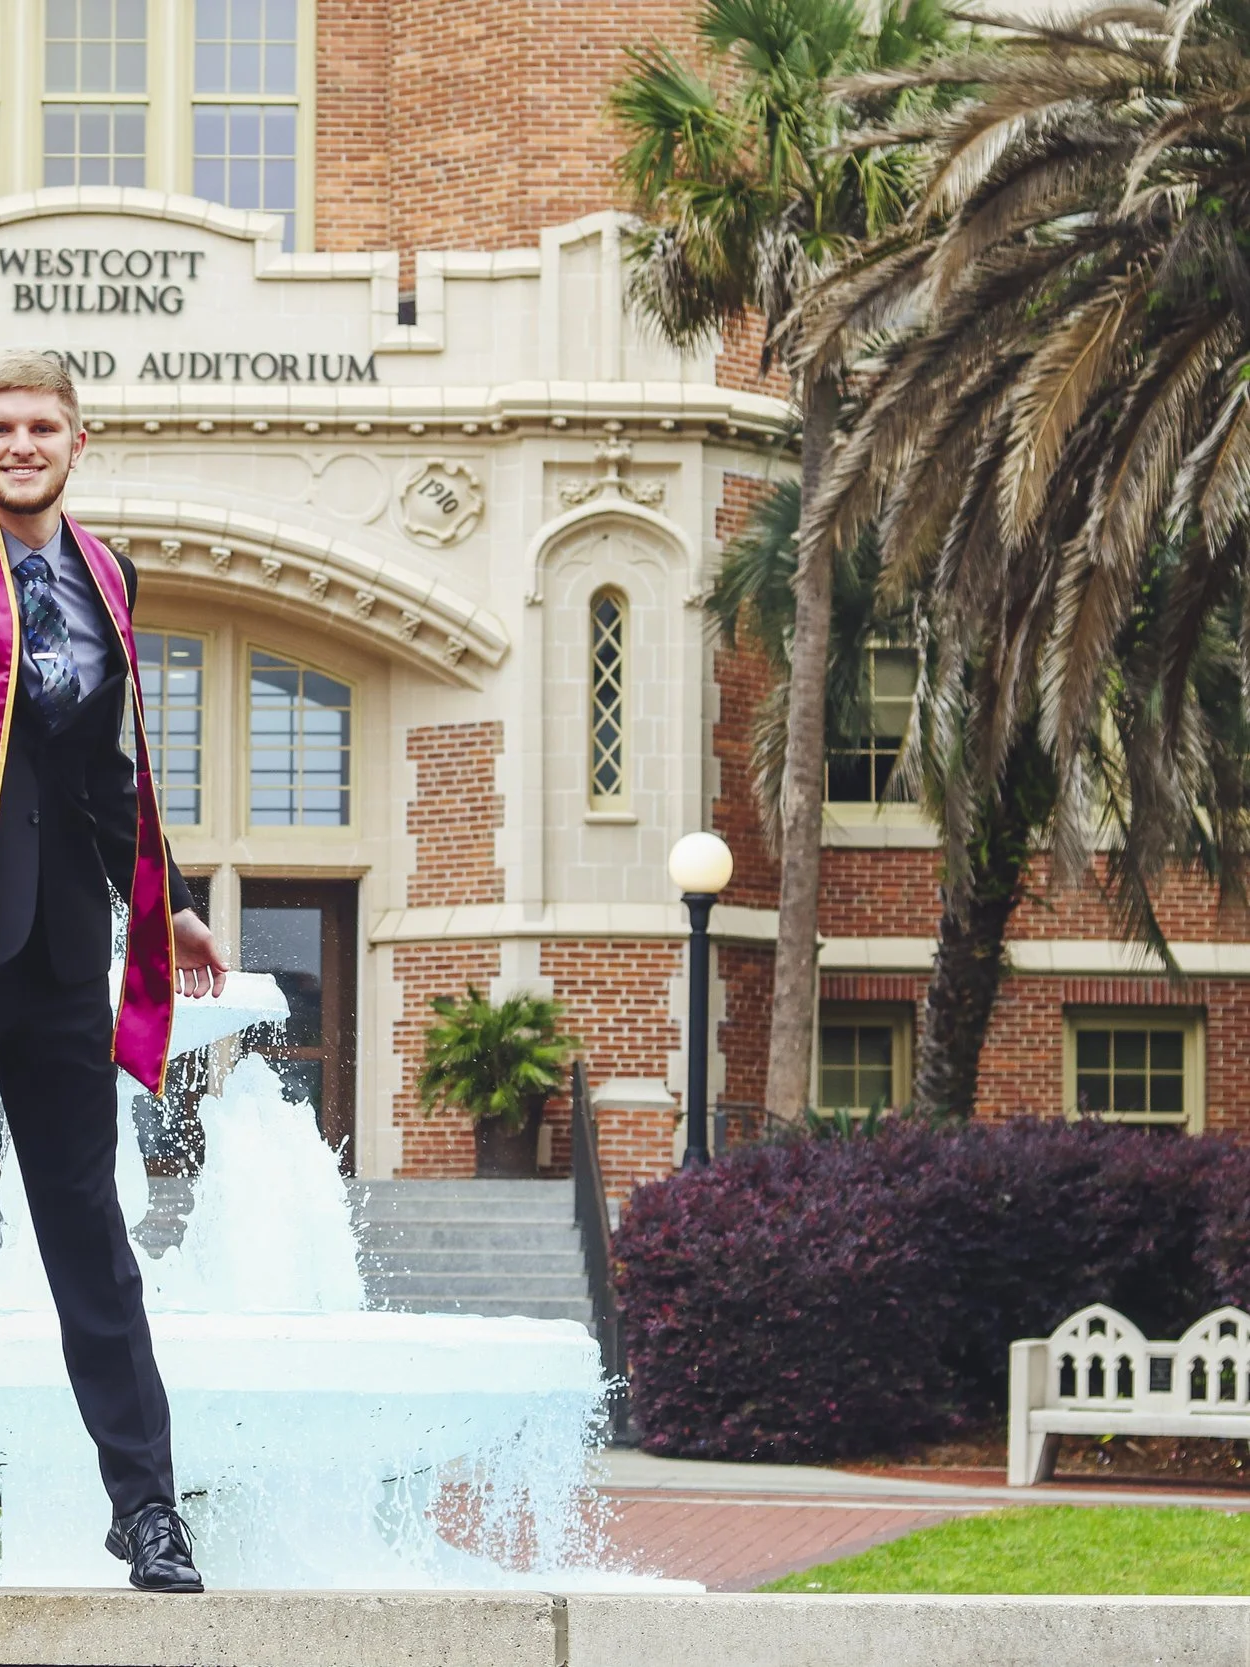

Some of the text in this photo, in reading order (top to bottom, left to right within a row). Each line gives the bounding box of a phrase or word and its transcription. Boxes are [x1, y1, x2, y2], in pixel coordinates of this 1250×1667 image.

[13, 283, 184, 315] BUILDING
[137, 351, 380, 382] AUDITORIUM
[418, 478, 459, 514] 1910
